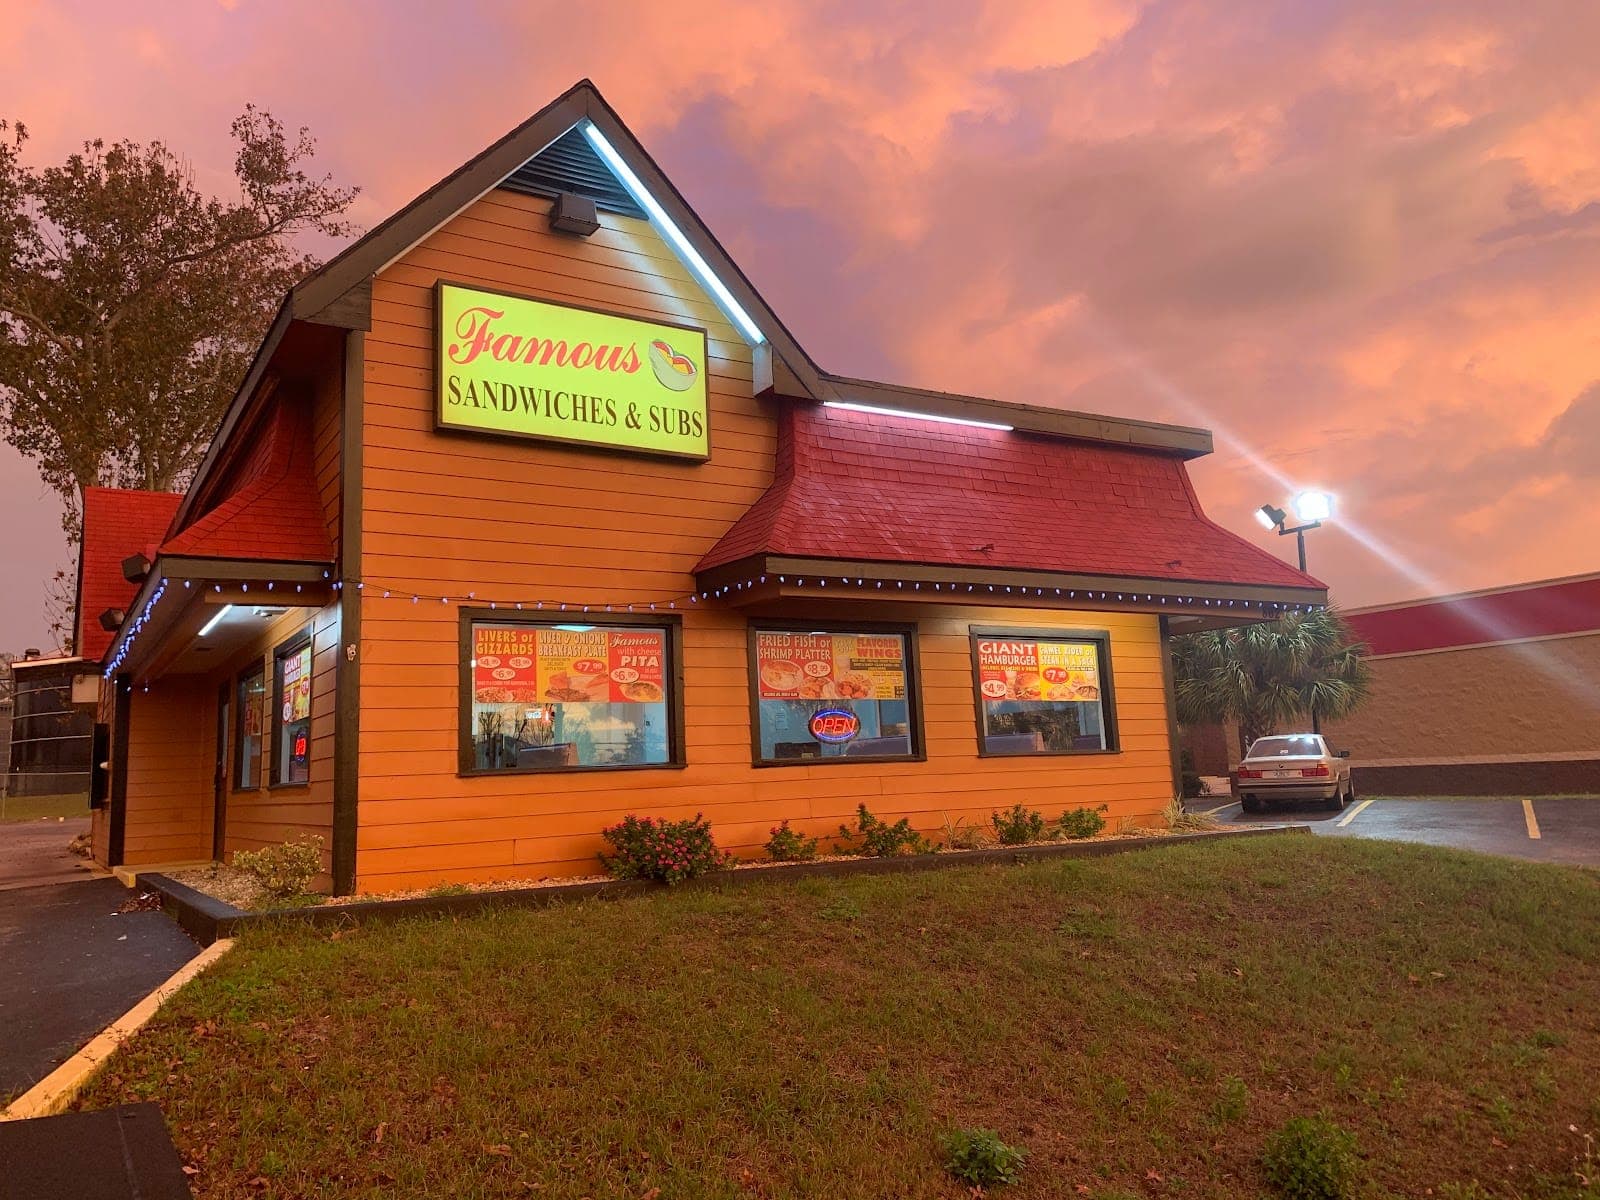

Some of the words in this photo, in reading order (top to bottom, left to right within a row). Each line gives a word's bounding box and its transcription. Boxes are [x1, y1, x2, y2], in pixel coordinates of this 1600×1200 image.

[448, 307, 642, 374] Famous
[448, 375, 617, 427] SANDWICHES
[625, 402, 642, 430] &
[649, 405, 704, 438] SUBS
[478, 630, 517, 642] LIVERS
[521, 634, 533, 642] or
[539, 631, 562, 644] LIVER
[574, 632, 606, 645] ONIONS
[609, 633, 659, 648] Famous
[760, 635, 791, 647] FRIED
[794, 635, 817, 648] FISH
[820, 640, 831, 648] or
[476, 642, 534, 655] GIZZARDS
[538, 644, 582, 657] BREAKFAST
[584, 646, 608, 658] PLATE
[617, 647, 635, 655] with
[637, 647, 662, 656] cheese
[759, 647, 793, 659] SHRIMP
[795, 649, 832, 660] PLATTER
[857, 648, 902, 658] WINGS
[979, 642, 1036, 655] GIANT
[577, 661, 603, 672] $7.99
[620, 655, 660, 667] PITA
[980, 655, 1037, 666] HAMBURGER
[813, 718, 857, 734] OPEN
